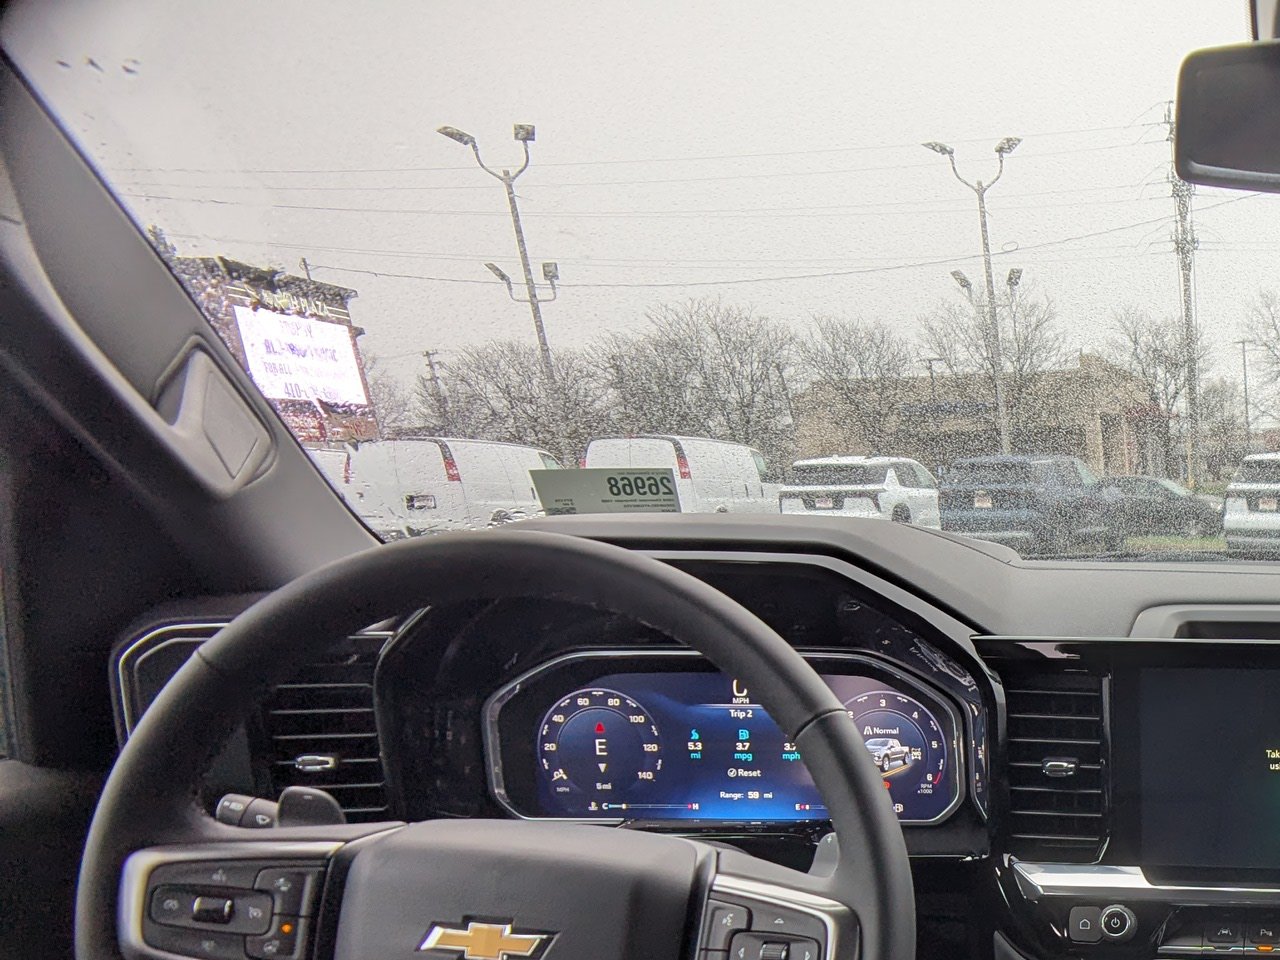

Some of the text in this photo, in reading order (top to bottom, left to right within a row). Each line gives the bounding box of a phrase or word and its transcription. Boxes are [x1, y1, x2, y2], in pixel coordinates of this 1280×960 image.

[577, 698, 589, 706] 60
[608, 698, 620, 706] 80
[729, 710, 753, 719] Trip 2
[552, 715, 565, 723] 40
[629, 715, 645, 723] 100
[873, 727, 899, 735] Normal
[544, 743, 557, 751] 20
[595, 739, 608, 755] E
[643, 744, 658, 752] 120
[688, 742, 702, 751] 5.3
[736, 742, 750, 751] 3.7
[932, 741, 938, 749] 5
[734, 752, 752, 761] mpg
[783, 752, 800, 761] mph
[638, 772, 653, 780] 140
[738, 769, 761, 777] Reset
[720, 792, 744, 801] Range:
